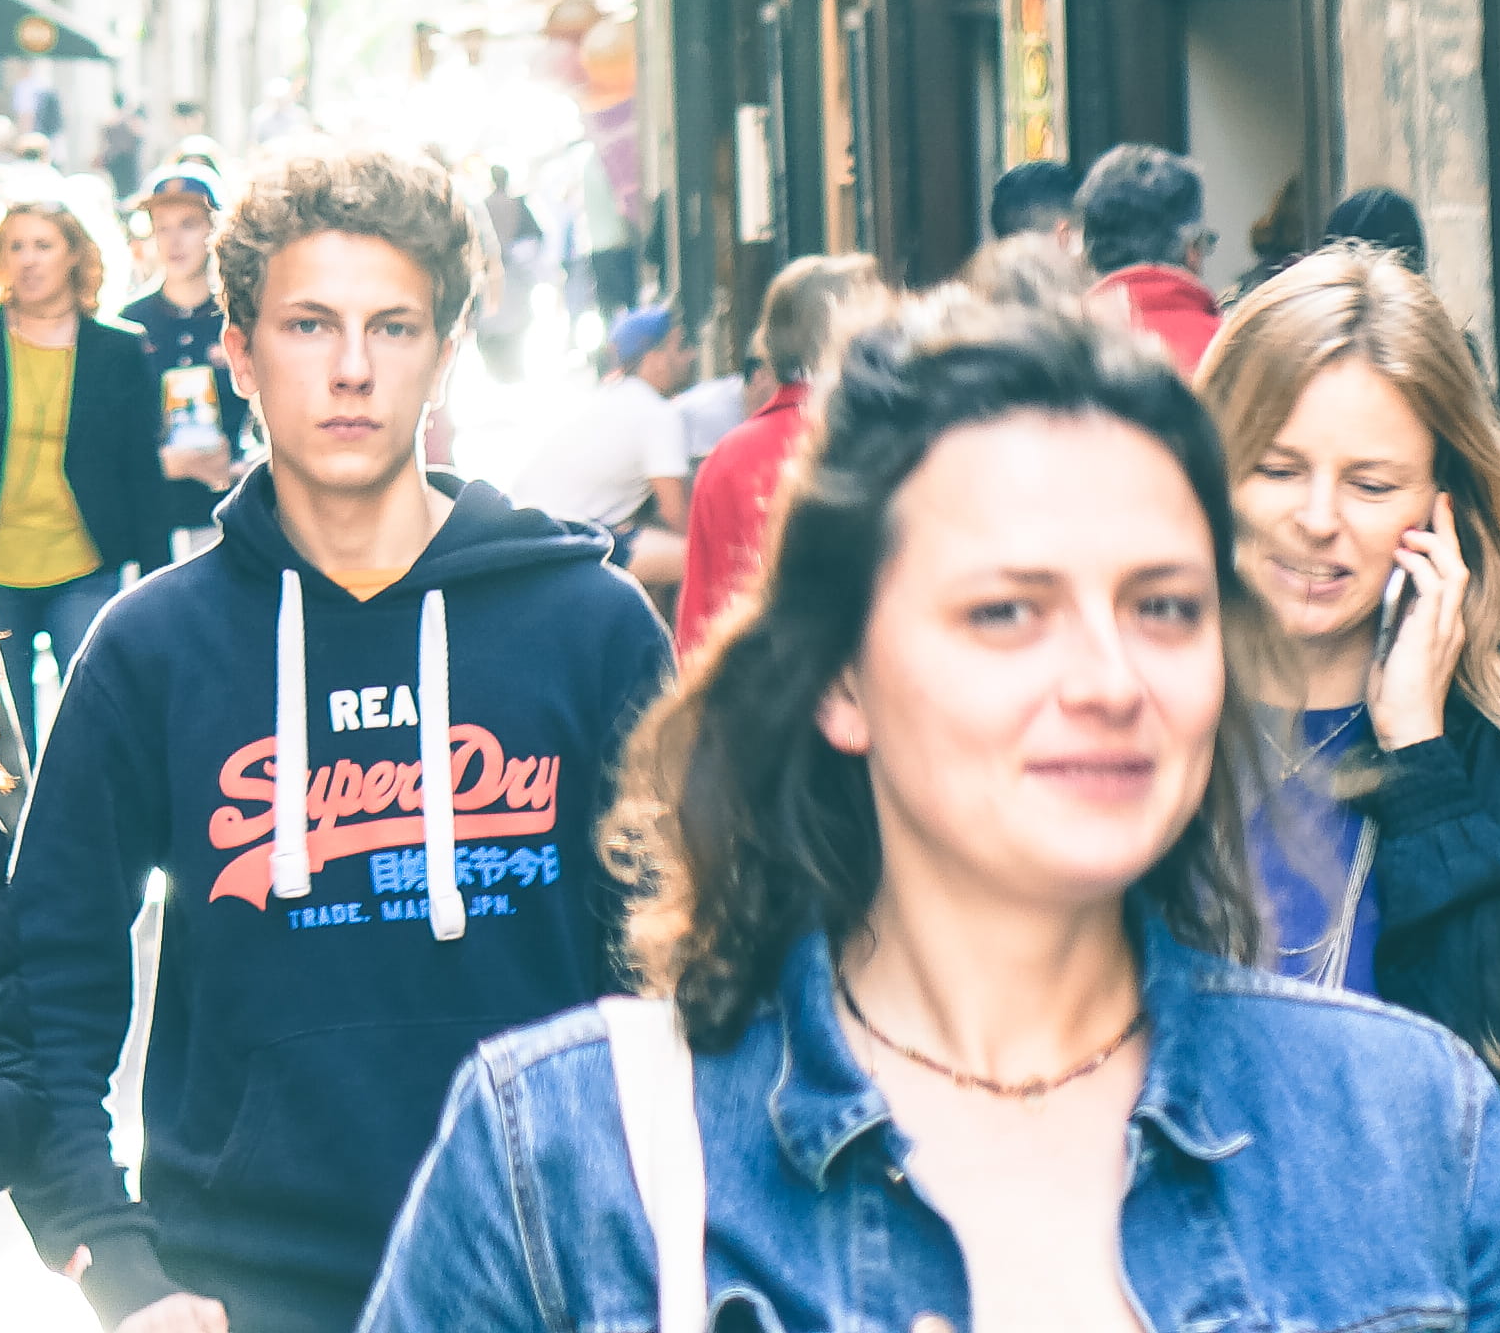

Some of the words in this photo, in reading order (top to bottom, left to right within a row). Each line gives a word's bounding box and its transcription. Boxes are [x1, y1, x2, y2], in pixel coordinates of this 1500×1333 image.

[329, 684, 420, 733] REA
[288, 902, 372, 930] TRADE.
[380, 897, 430, 922] MAR
